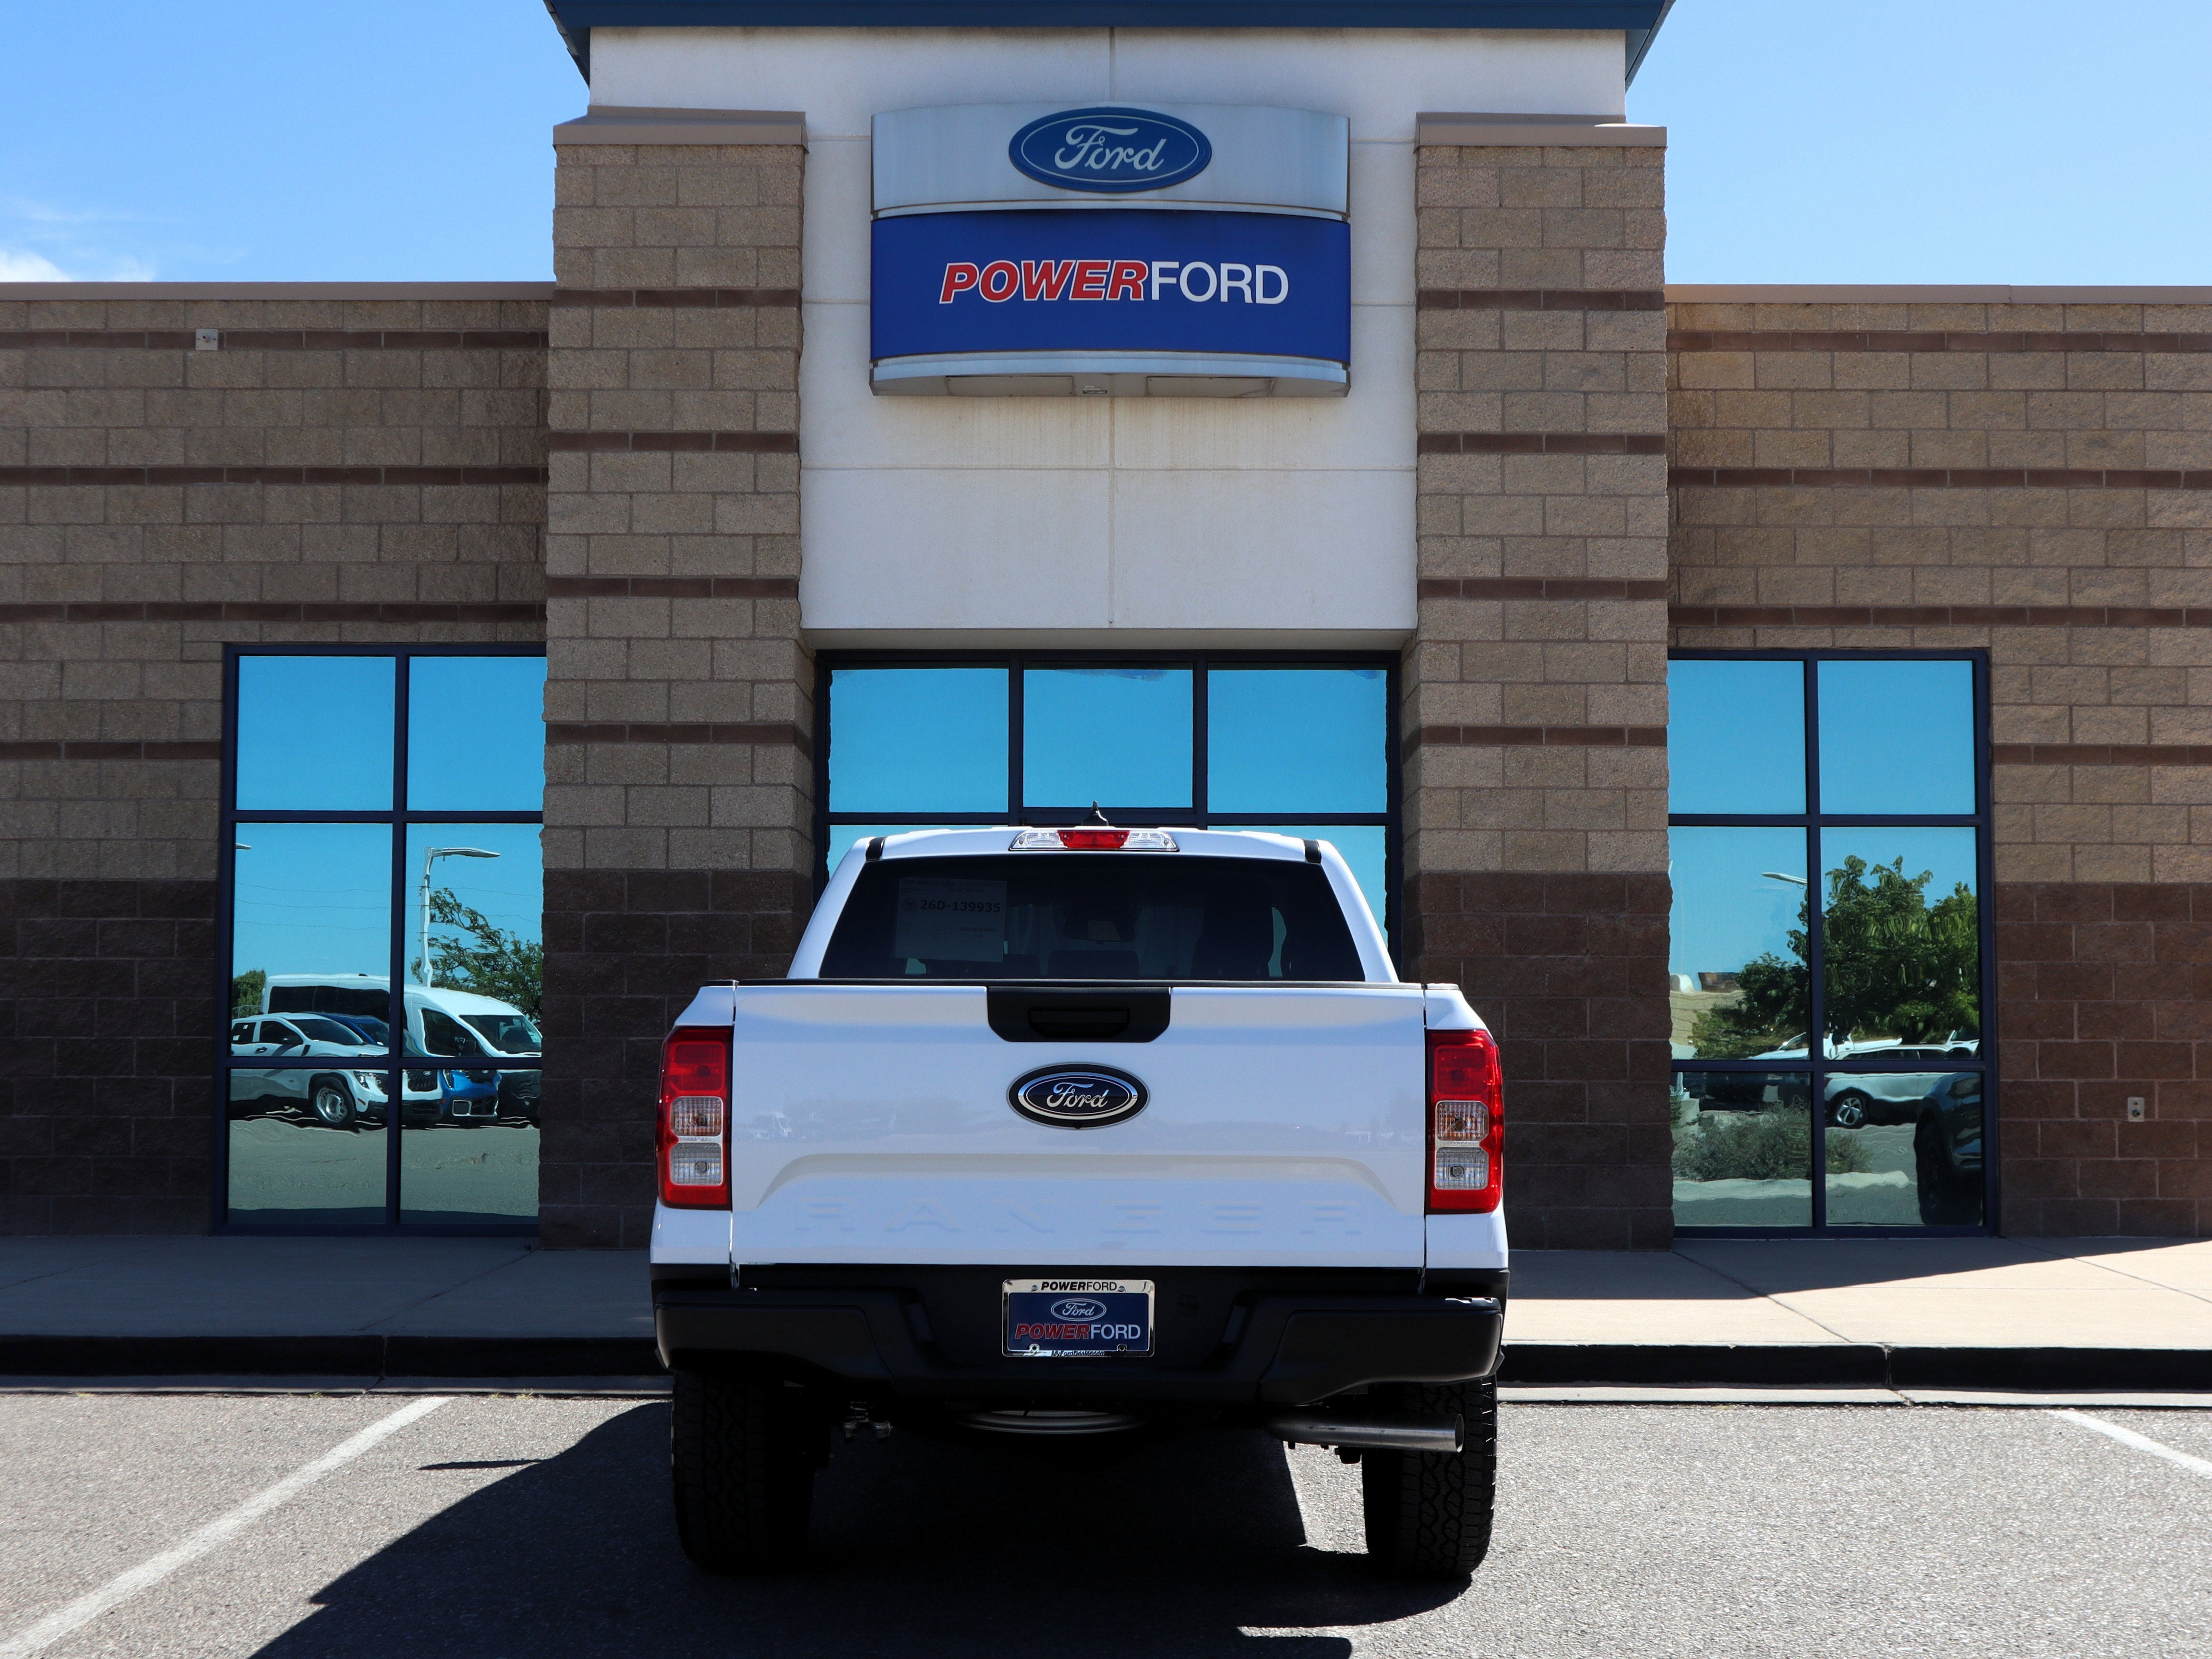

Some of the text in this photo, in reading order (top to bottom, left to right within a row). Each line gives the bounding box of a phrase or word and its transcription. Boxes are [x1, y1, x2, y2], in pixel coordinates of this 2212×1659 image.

[1054, 124, 1165, 172] Ford
[920, 899, 1001, 914] 26D-139935
[1046, 1082, 1110, 1108] Ford
[1062, 1302, 1095, 1316] Ford
